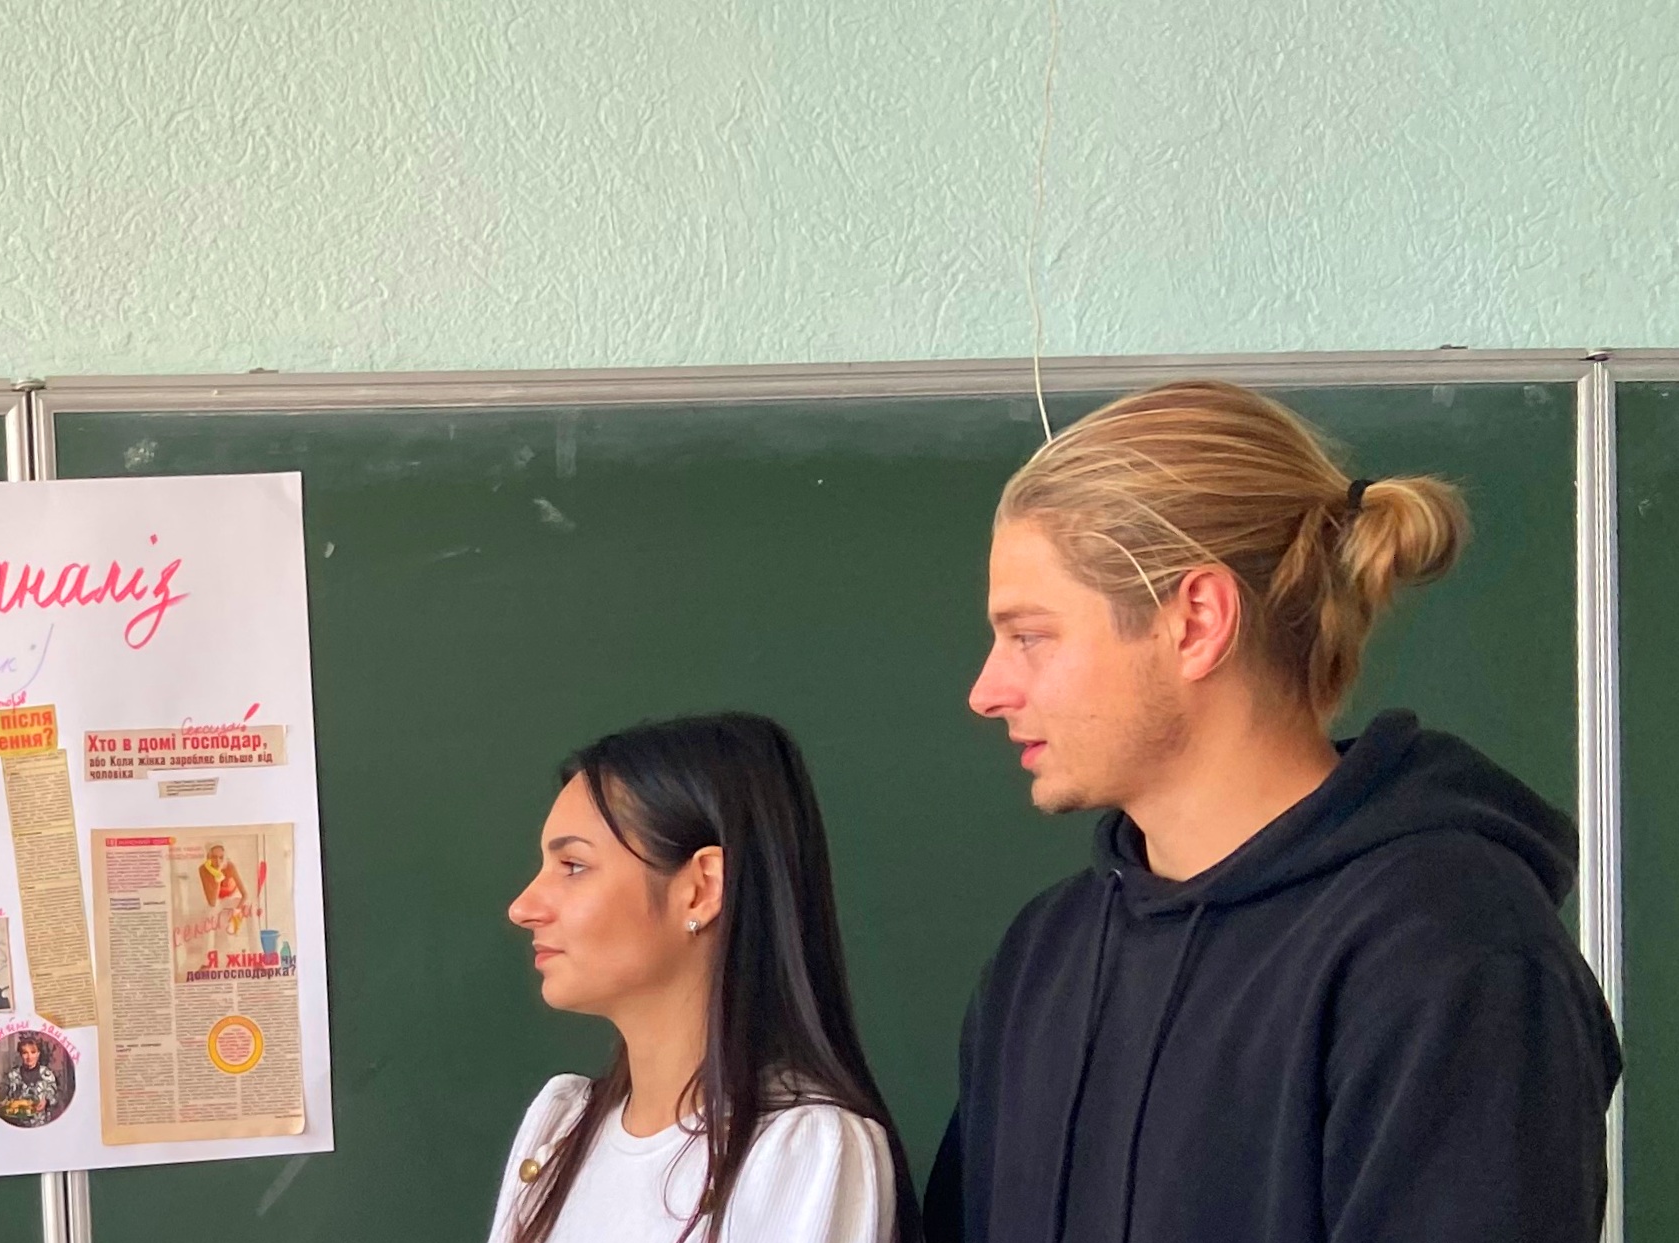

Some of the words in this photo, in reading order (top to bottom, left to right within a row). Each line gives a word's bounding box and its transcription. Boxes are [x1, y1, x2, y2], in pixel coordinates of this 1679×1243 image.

[0, 710, 53, 731] після
[87, 734, 117, 753] Хто
[123, 737, 132, 751] в
[137, 733, 176, 754] домі
[182, 734, 268, 752] господар,
[89, 756, 106, 767] або
[109, 755, 134, 767] Коли
[137, 754, 166, 767] жінка
[170, 753, 215, 767] заробляє
[218, 752, 254, 765] більше
[257, 751, 274, 764] від
[89, 767, 134, 780] чоловіка
[206, 950, 219, 968] Я
[226, 949, 280, 968] жінка
[186, 964, 297, 983] домогосподарка?
